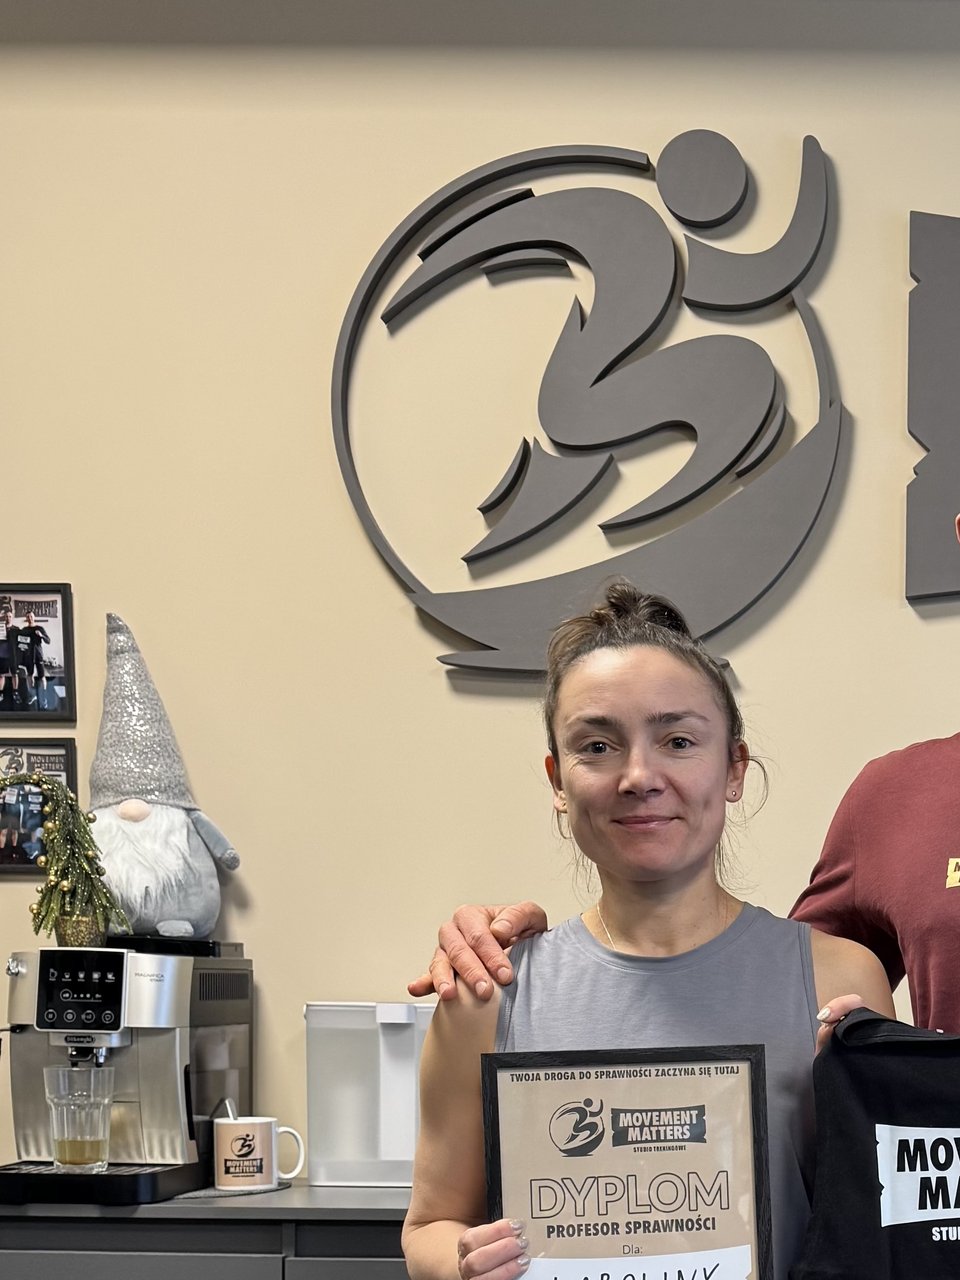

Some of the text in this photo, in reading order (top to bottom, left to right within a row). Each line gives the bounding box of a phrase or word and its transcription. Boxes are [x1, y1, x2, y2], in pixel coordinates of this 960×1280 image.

[510, 1066, 740, 1082] TWOJA DROGA DO SPRAWNOŚCI ZACZYNA SIĘ TUTAJ
[619, 1110, 699, 1127] MOVEMENT
[627, 1125, 691, 1142] MATTERS
[530, 1170, 730, 1219] DYPLOM
[546, 1214, 716, 1238] PROFESOR SPRAWNOŚCI
[622, 1244, 643, 1255] Dla:
